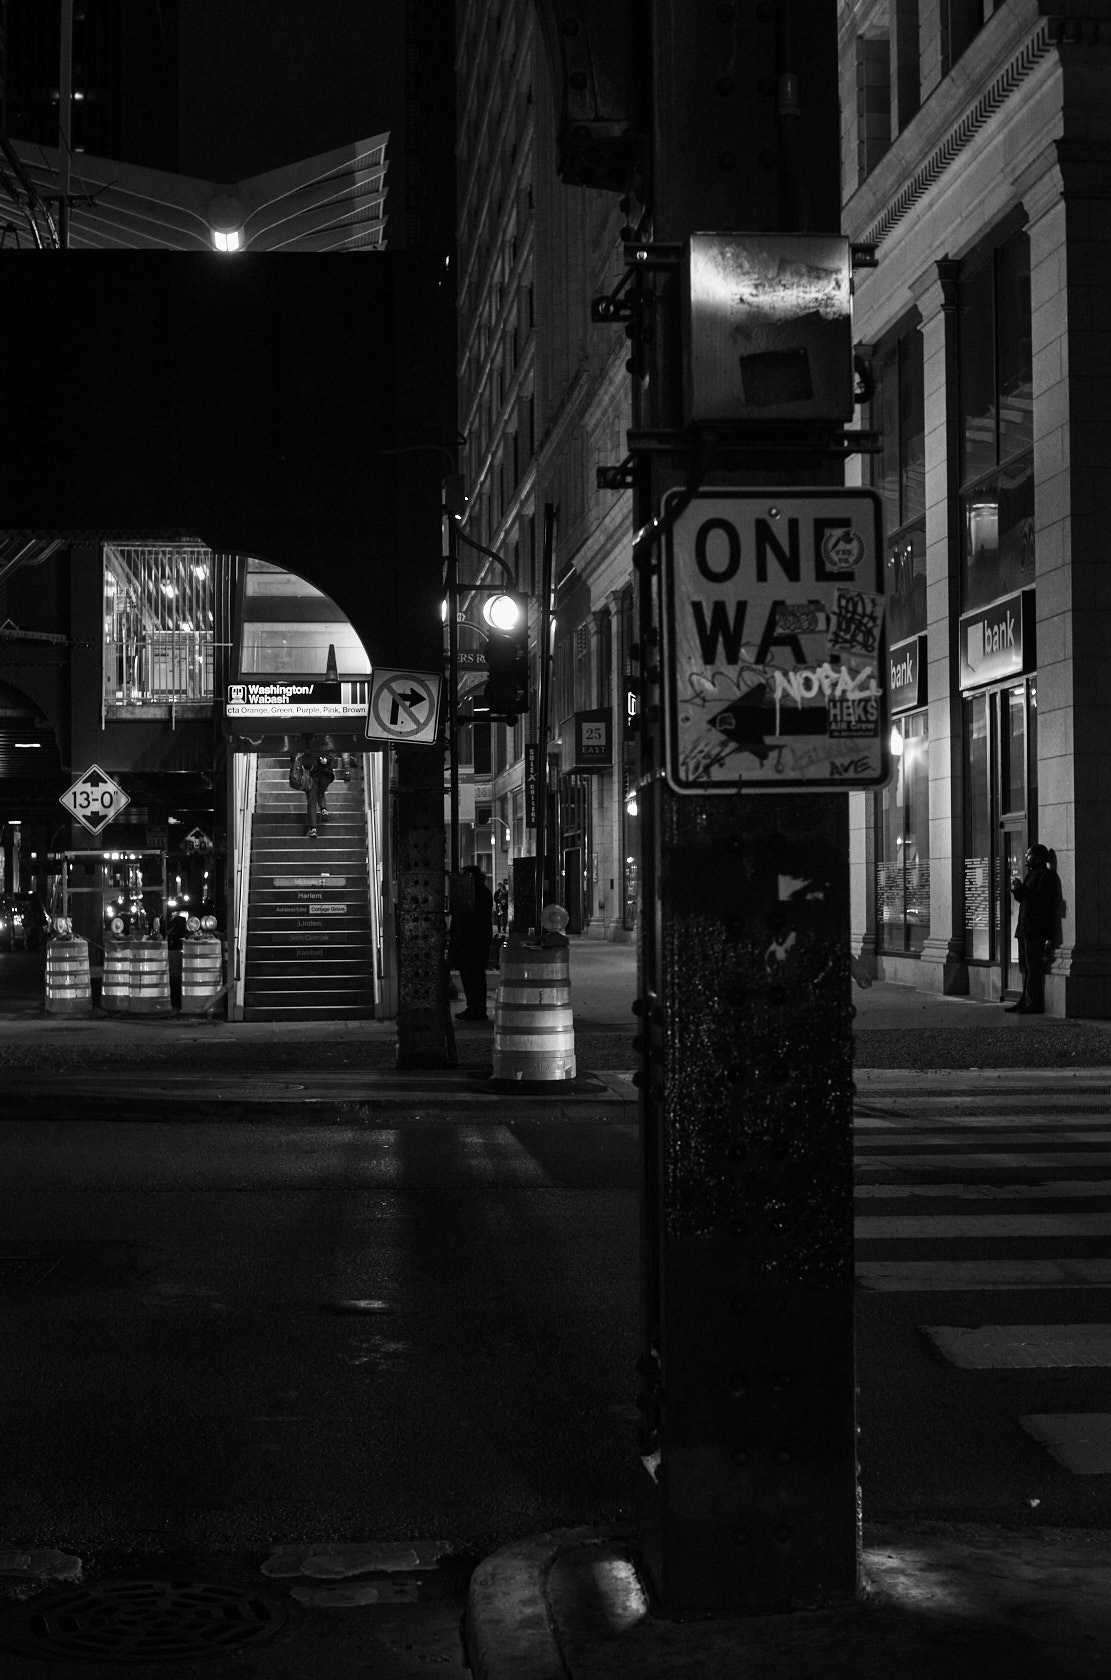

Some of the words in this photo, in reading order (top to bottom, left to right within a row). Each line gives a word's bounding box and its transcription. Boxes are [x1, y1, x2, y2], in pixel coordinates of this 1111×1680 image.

[694, 517, 855, 584] ONE
[691, 600, 852, 665] WA
[985, 610, 1015, 655] bank
[890, 652, 913, 690] bank
[248, 684, 314, 697] Washington/
[248, 694, 290, 704] Wabash
[241, 707, 270, 715] Orange,
[271, 707, 295, 715] Green,
[296, 707, 321, 716] Purple,
[323, 707, 341, 715] Pink,
[829, 701, 878, 721] HEKS
[586, 728, 602, 740] 25
[582, 746, 607, 754] EAST
[311, 905, 330, 913] Cottage
[298, 920, 322, 928] Linden
